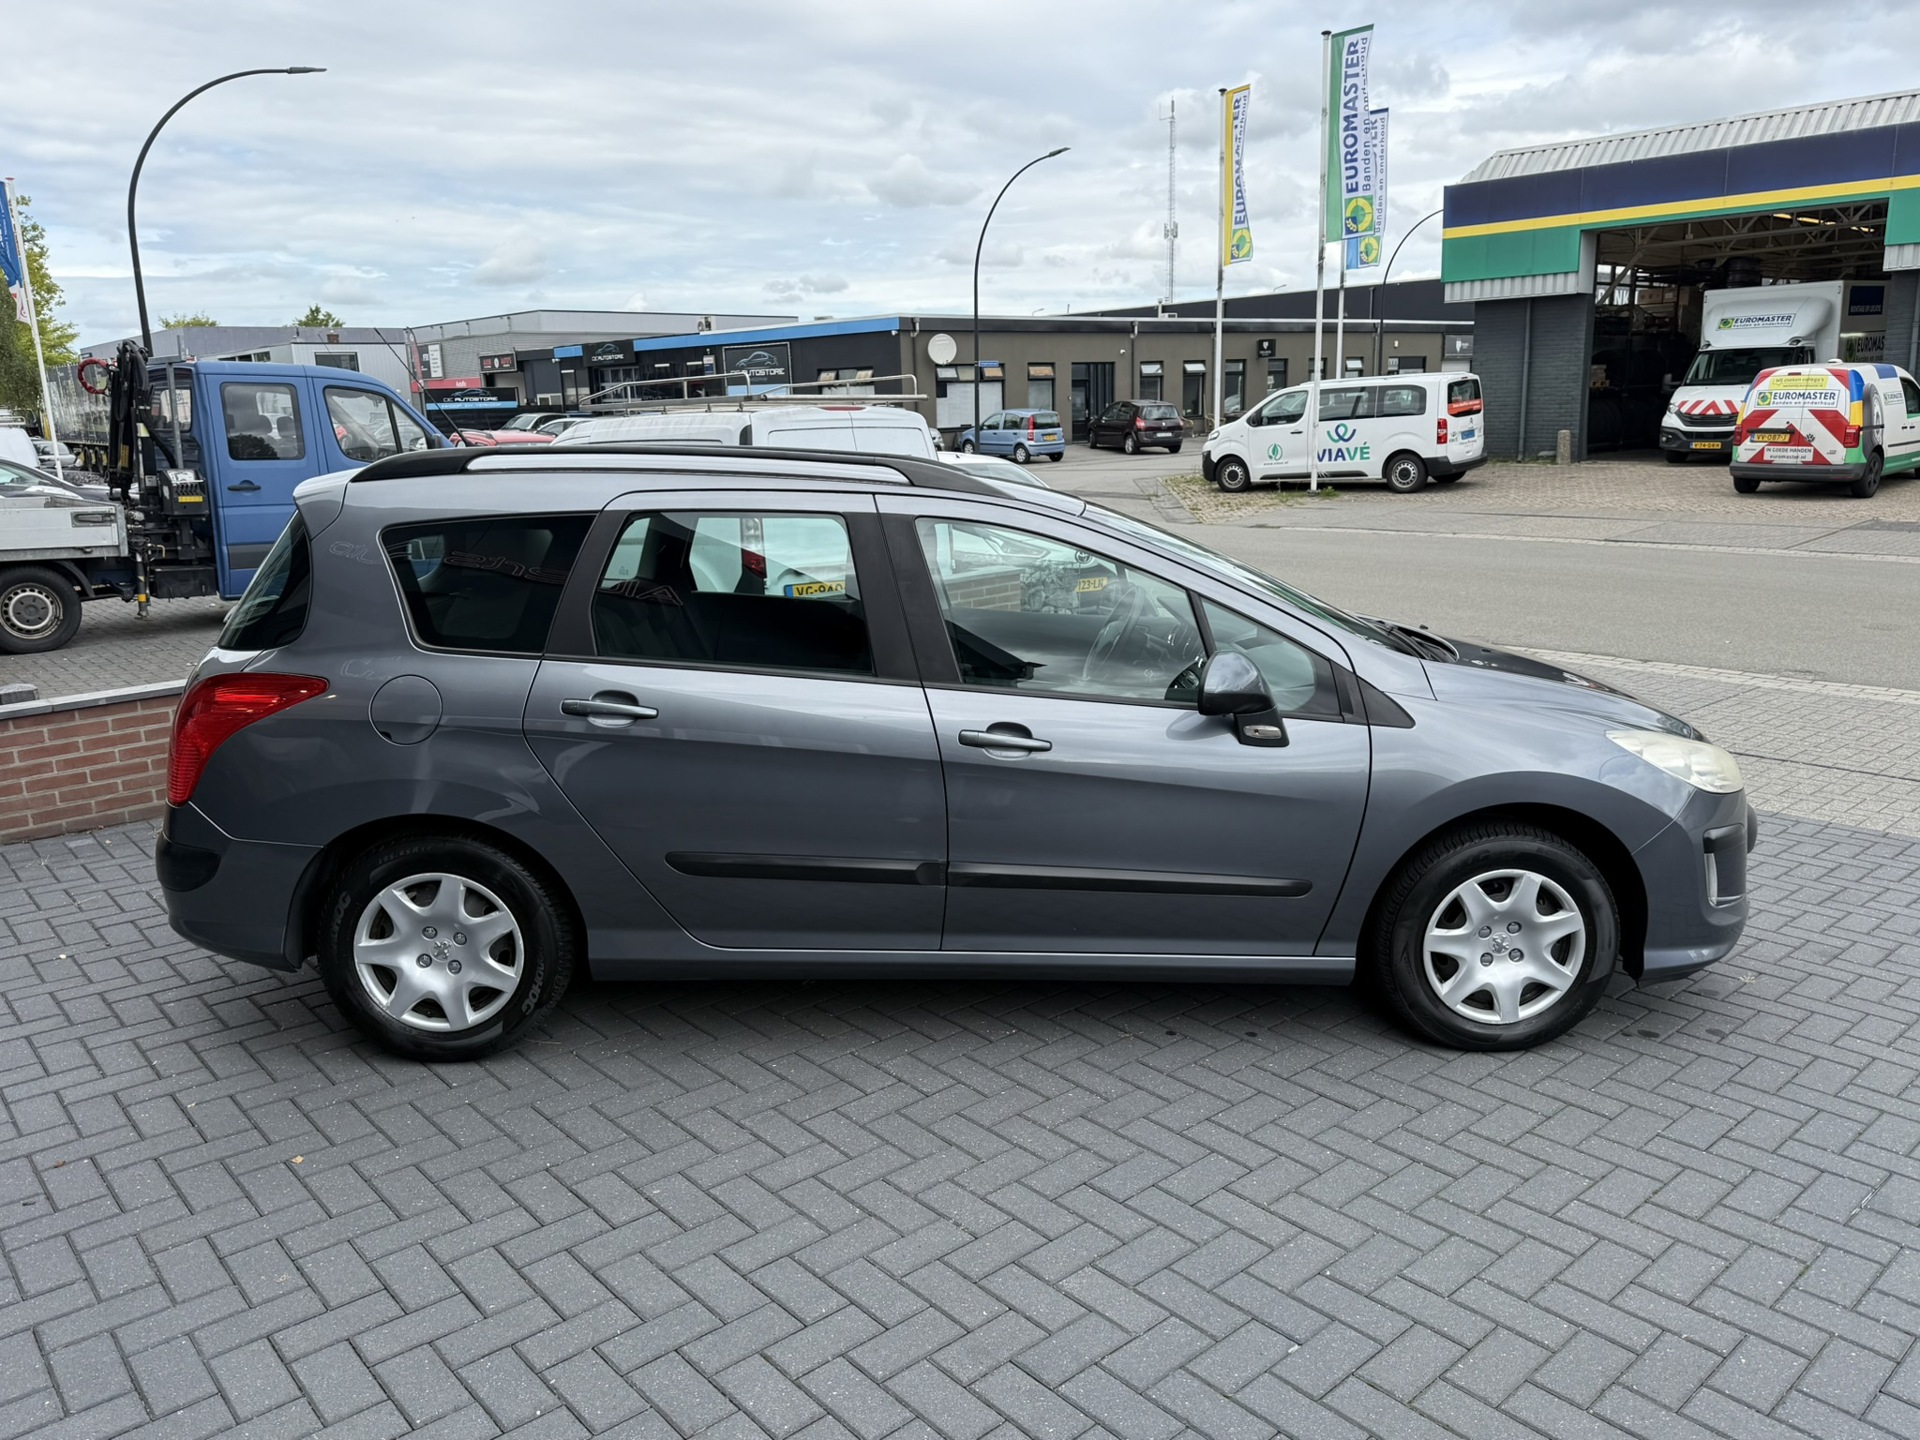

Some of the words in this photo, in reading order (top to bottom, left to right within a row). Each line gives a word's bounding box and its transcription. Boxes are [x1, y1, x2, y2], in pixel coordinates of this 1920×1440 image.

[1343, 39, 1359, 193] EUROMASTER
[1364, 118, 1370, 139] en
[1362, 143, 1370, 191] Banden
[1734, 315, 1792, 324] EUROMASTER
[1773, 392, 1836, 400] EUROMASTER
[1317, 441, 1370, 462] VIAVÉ
